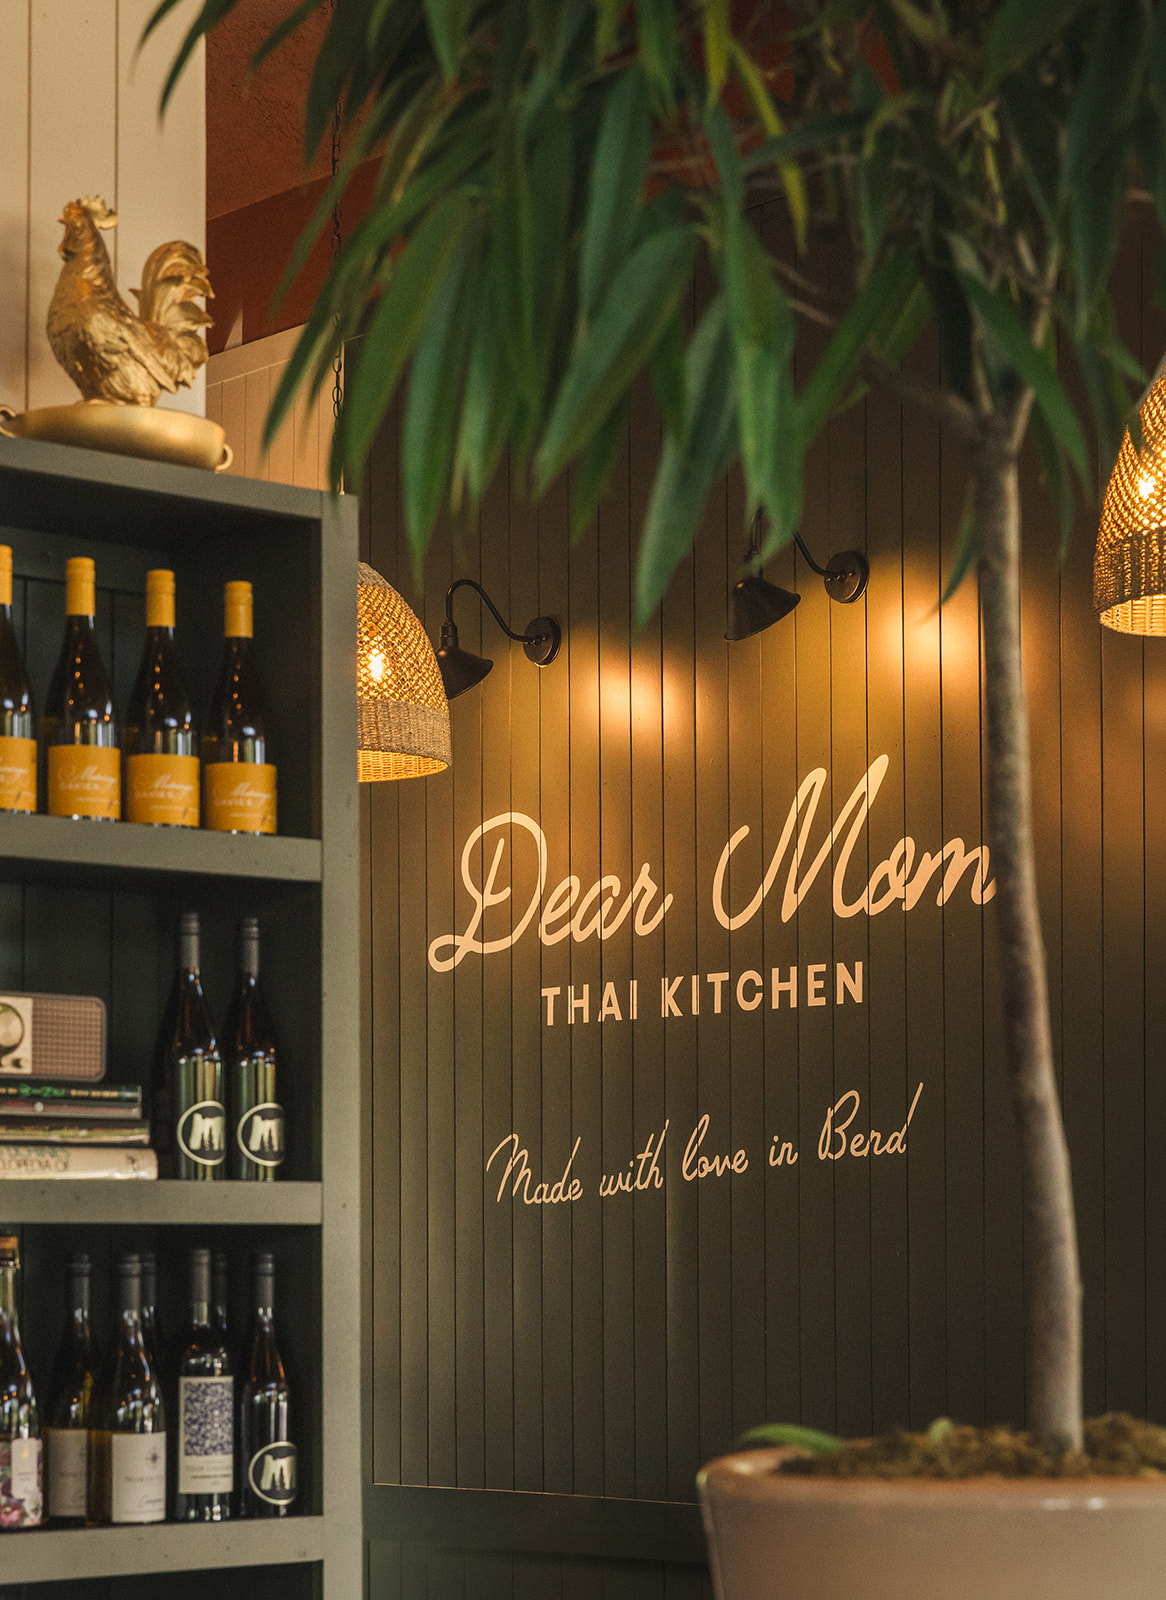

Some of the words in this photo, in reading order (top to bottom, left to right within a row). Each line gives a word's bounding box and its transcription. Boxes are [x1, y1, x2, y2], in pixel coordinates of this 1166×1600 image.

[428, 812, 674, 973] Dear
[712, 753, 997, 931] Mom
[541, 979, 639, 1026] THAI
[661, 961, 865, 1018] KITCHEN
[486, 1133, 583, 1206] Made
[599, 1119, 670, 1197] with
[682, 1113, 749, 1182] love
[769, 1135, 799, 1168] in
[817, 1082, 924, 1161] Bend
